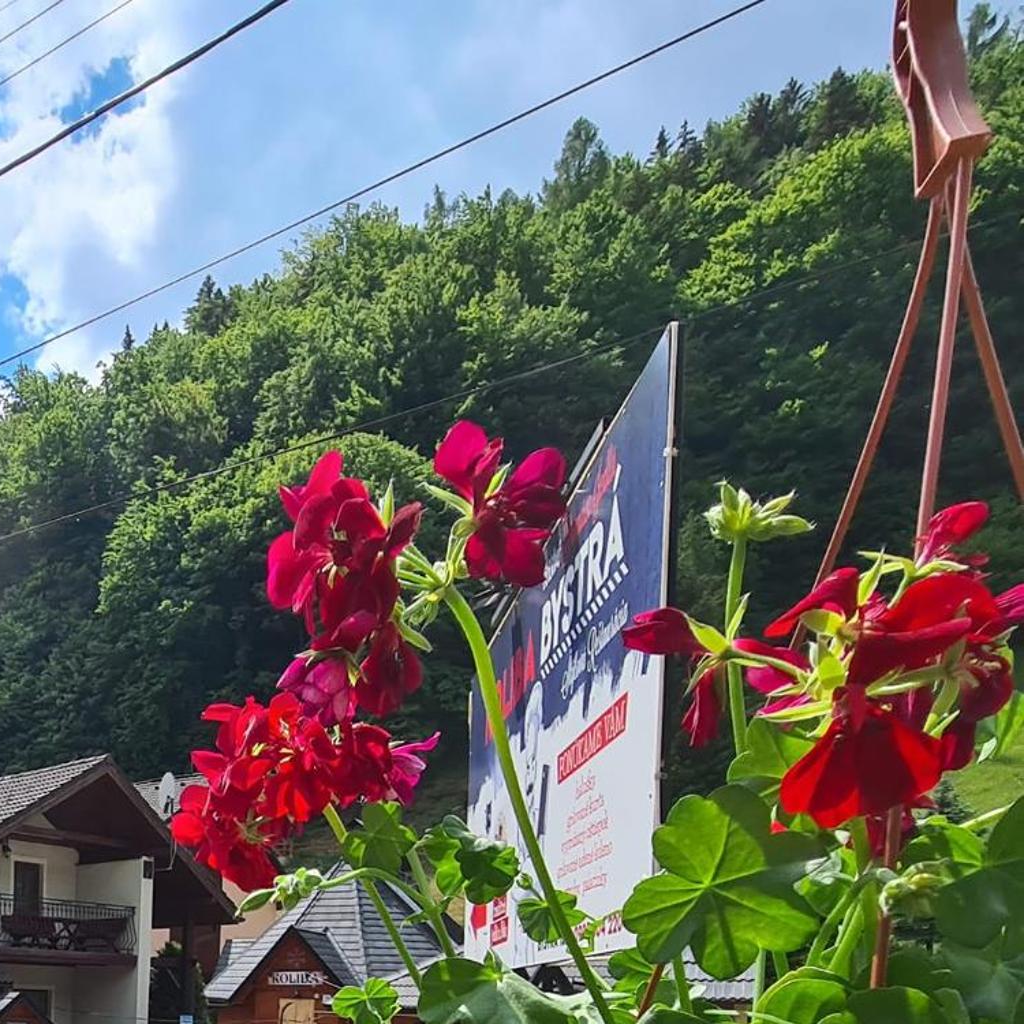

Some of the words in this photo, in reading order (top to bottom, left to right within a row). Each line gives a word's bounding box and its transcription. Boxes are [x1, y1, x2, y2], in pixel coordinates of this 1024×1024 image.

[485, 629, 535, 750] LIBA
[540, 463, 625, 668] BYSTRÁ
[603, 699, 626, 743] VÁM
